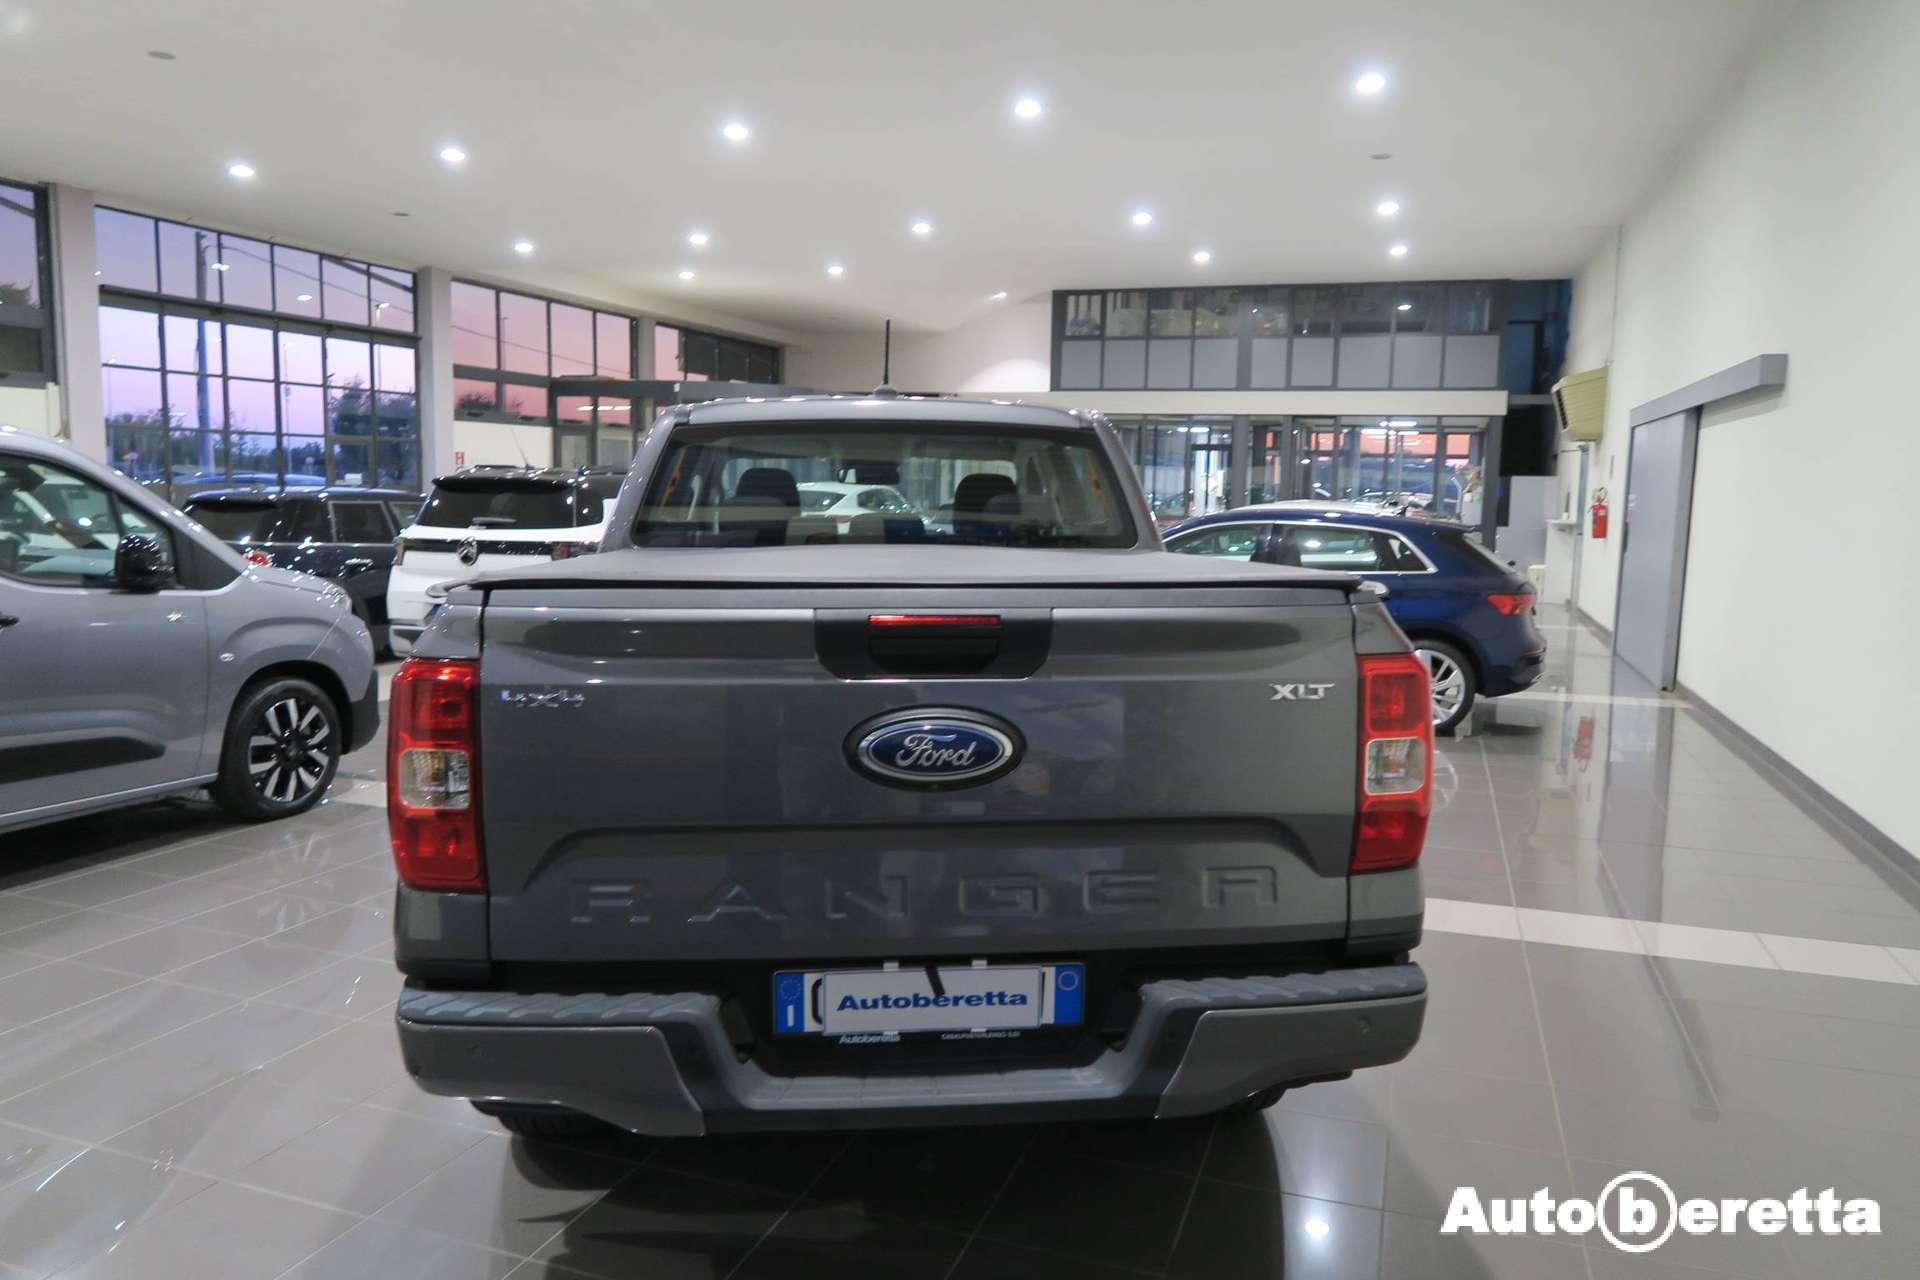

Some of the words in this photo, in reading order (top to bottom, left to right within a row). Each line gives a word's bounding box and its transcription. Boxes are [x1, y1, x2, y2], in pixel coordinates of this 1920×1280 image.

[1268, 683, 1336, 700] XLT
[895, 733, 977, 767] Ford
[570, 866, 1279, 924] RANGER
[837, 990, 1028, 1011] Autoberetta
